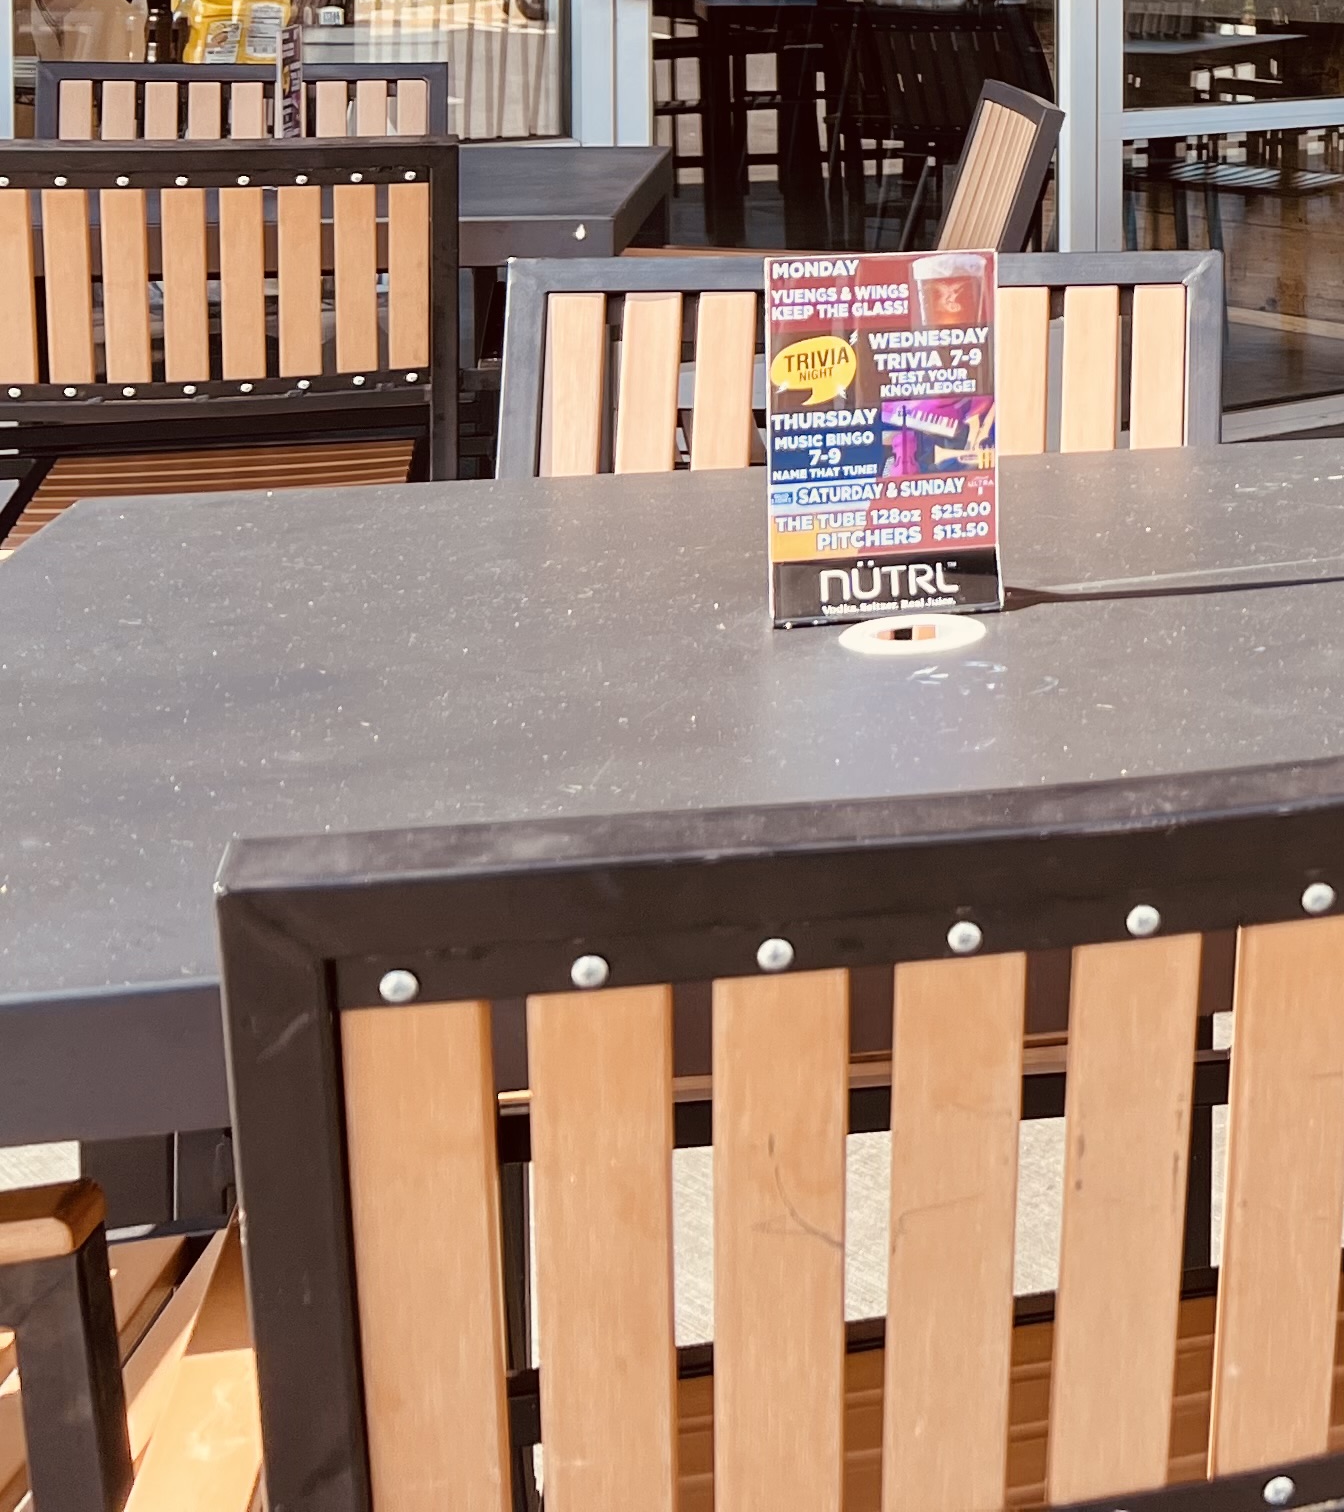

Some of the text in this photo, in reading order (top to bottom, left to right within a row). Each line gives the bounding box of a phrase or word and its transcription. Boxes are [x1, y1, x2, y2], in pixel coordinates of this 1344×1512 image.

[772, 259, 860, 280] MONDAY
[771, 284, 909, 304] YUENGS & WINGS
[771, 300, 909, 321] KEEP THE GLASS!
[868, 327, 989, 349] WEDNESDAY
[784, 346, 850, 373] TRIVIA
[873, 348, 982, 371] TRIVIA 7-9
[799, 366, 834, 382] NIGHT
[888, 368, 968, 384] TEST YOUR
[880, 379, 977, 398] KNOWLEDGE!
[771, 408, 878, 431] THURSDAY
[774, 431, 875, 451] MUSIC BINGO
[808, 447, 842, 466] 7-9
[772, 464, 878, 481] NAME THAT TUNE!
[797, 483, 884, 504] SATURDAY
[885, 481, 898, 499] &
[900, 477, 966, 496] SUNDAY
[775, 501, 992, 532] THE TUBE 128oz $25.00
[816, 522, 990, 552] PITCHERS $13.50
